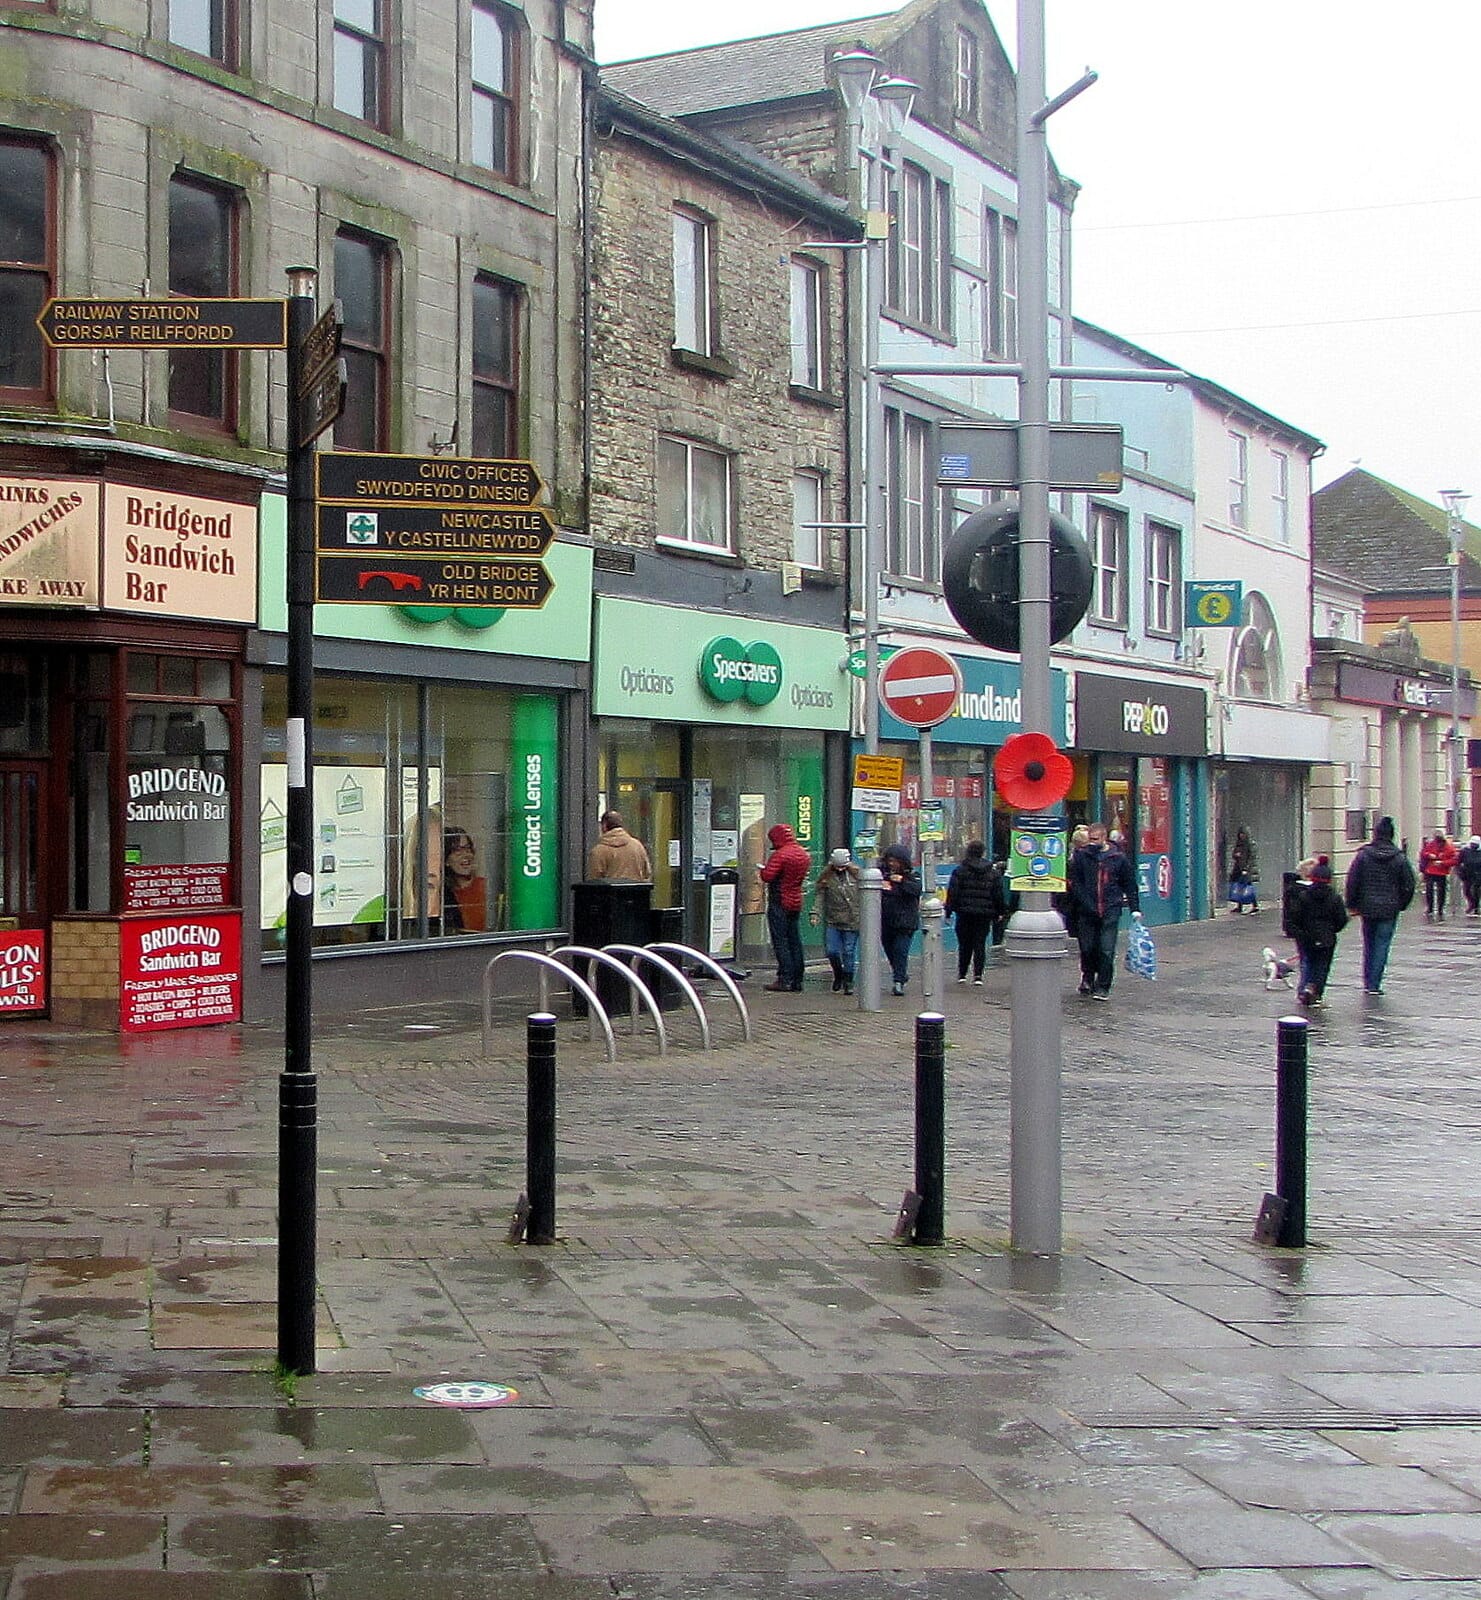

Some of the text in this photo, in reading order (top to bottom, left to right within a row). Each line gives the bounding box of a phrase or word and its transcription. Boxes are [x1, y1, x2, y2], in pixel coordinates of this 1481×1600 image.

[54, 305, 200, 320] RAILWAY STATION
[54, 325, 234, 340] GORSAF REILFFORDD
[420, 463, 529, 483] CIVIC OFFICES
[356, 480, 530, 501] SWYDDFEYDD DINESIG
[0, 491, 83, 562] NDWICHES
[126, 496, 232, 541] Bridgend
[441, 513, 541, 530] NEWCASTLE
[385, 531, 541, 549] Y CASTELLNEWYDD
[125, 534, 236, 576] Sandwich
[442, 565, 539, 582] OLD BRIDGE
[0, 578, 86, 597] KE AWAY
[126, 572, 168, 604] Bar
[428, 583, 539, 600] YR HEN BONT
[713, 653, 778, 685] Specsavers
[621, 665, 674, 698] Opticians
[791, 683, 834, 710] Opticians
[952, 685, 1022, 723] undland
[128, 768, 226, 799] BRIDGEND
[126, 800, 227, 821] Sandwich Bar
[524, 754, 541, 877] Contact Lenses
[796, 796, 811, 840] Lenses
[141, 924, 220, 954] BRIDGEND
[0, 944, 39, 965] ON
[140, 950, 222, 972] Sandwich Bar
[0, 964, 34, 988] LLS
